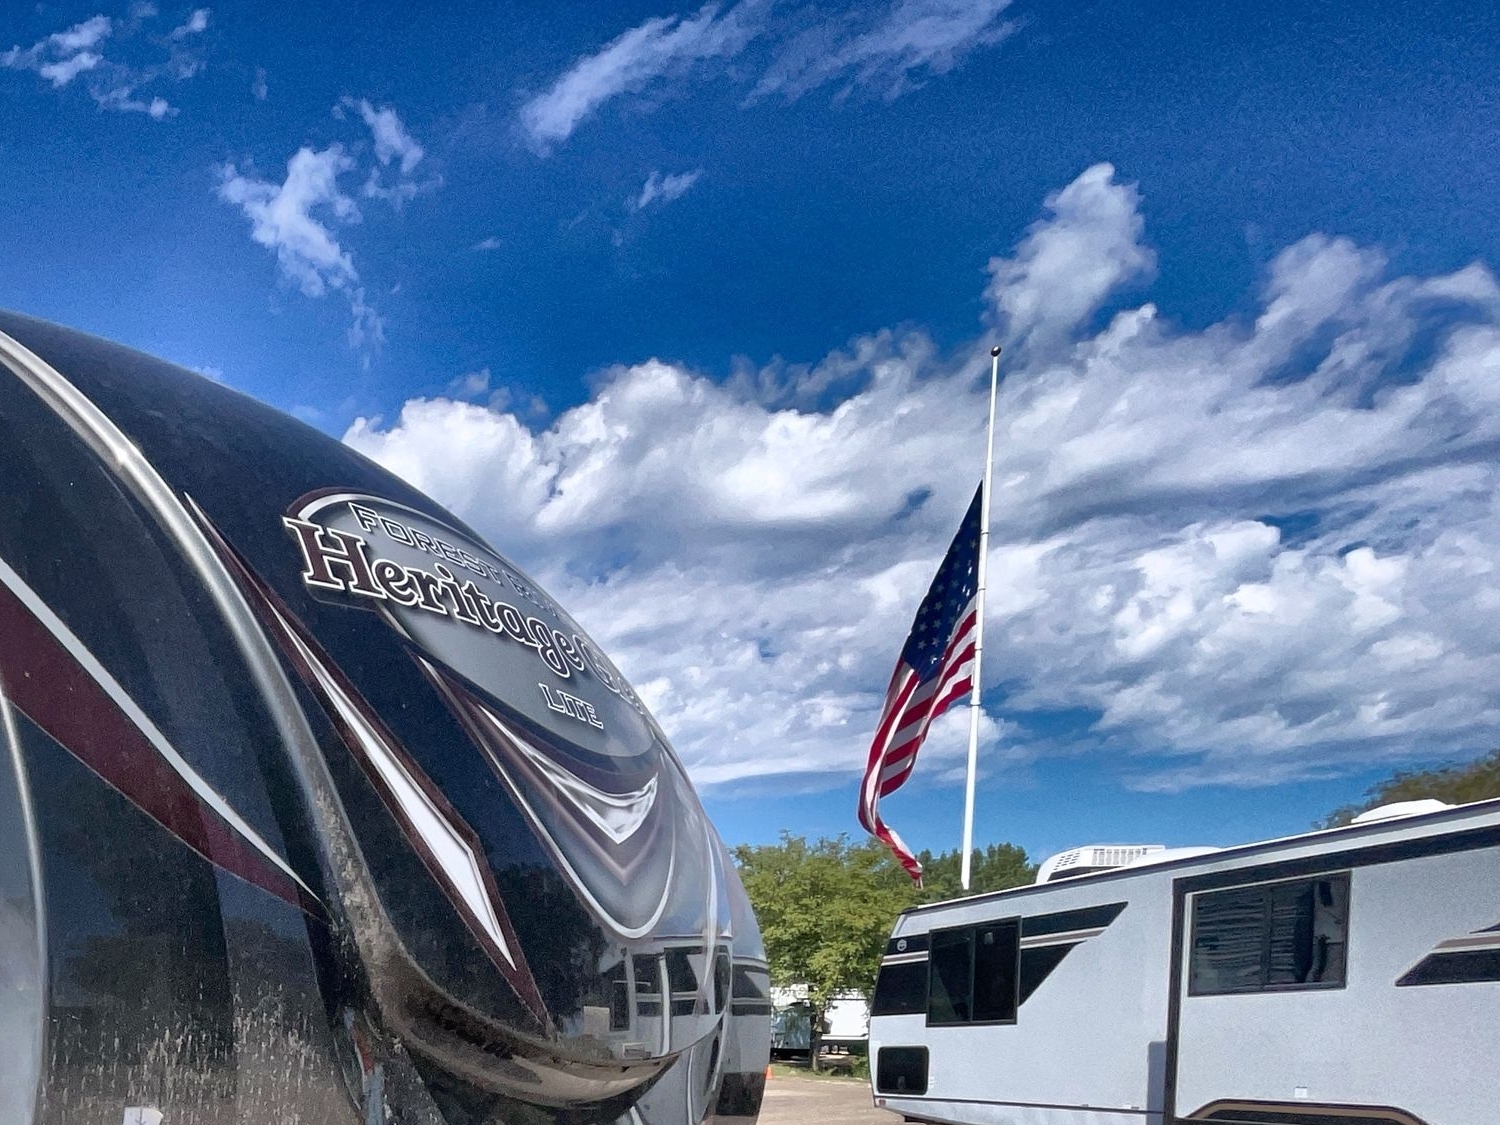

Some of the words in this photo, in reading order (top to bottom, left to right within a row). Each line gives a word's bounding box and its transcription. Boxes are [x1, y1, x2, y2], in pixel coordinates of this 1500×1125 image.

[347, 501, 501, 585] FOREST
[281, 515, 585, 678] Heritage
[538, 682, 604, 730] LITE
